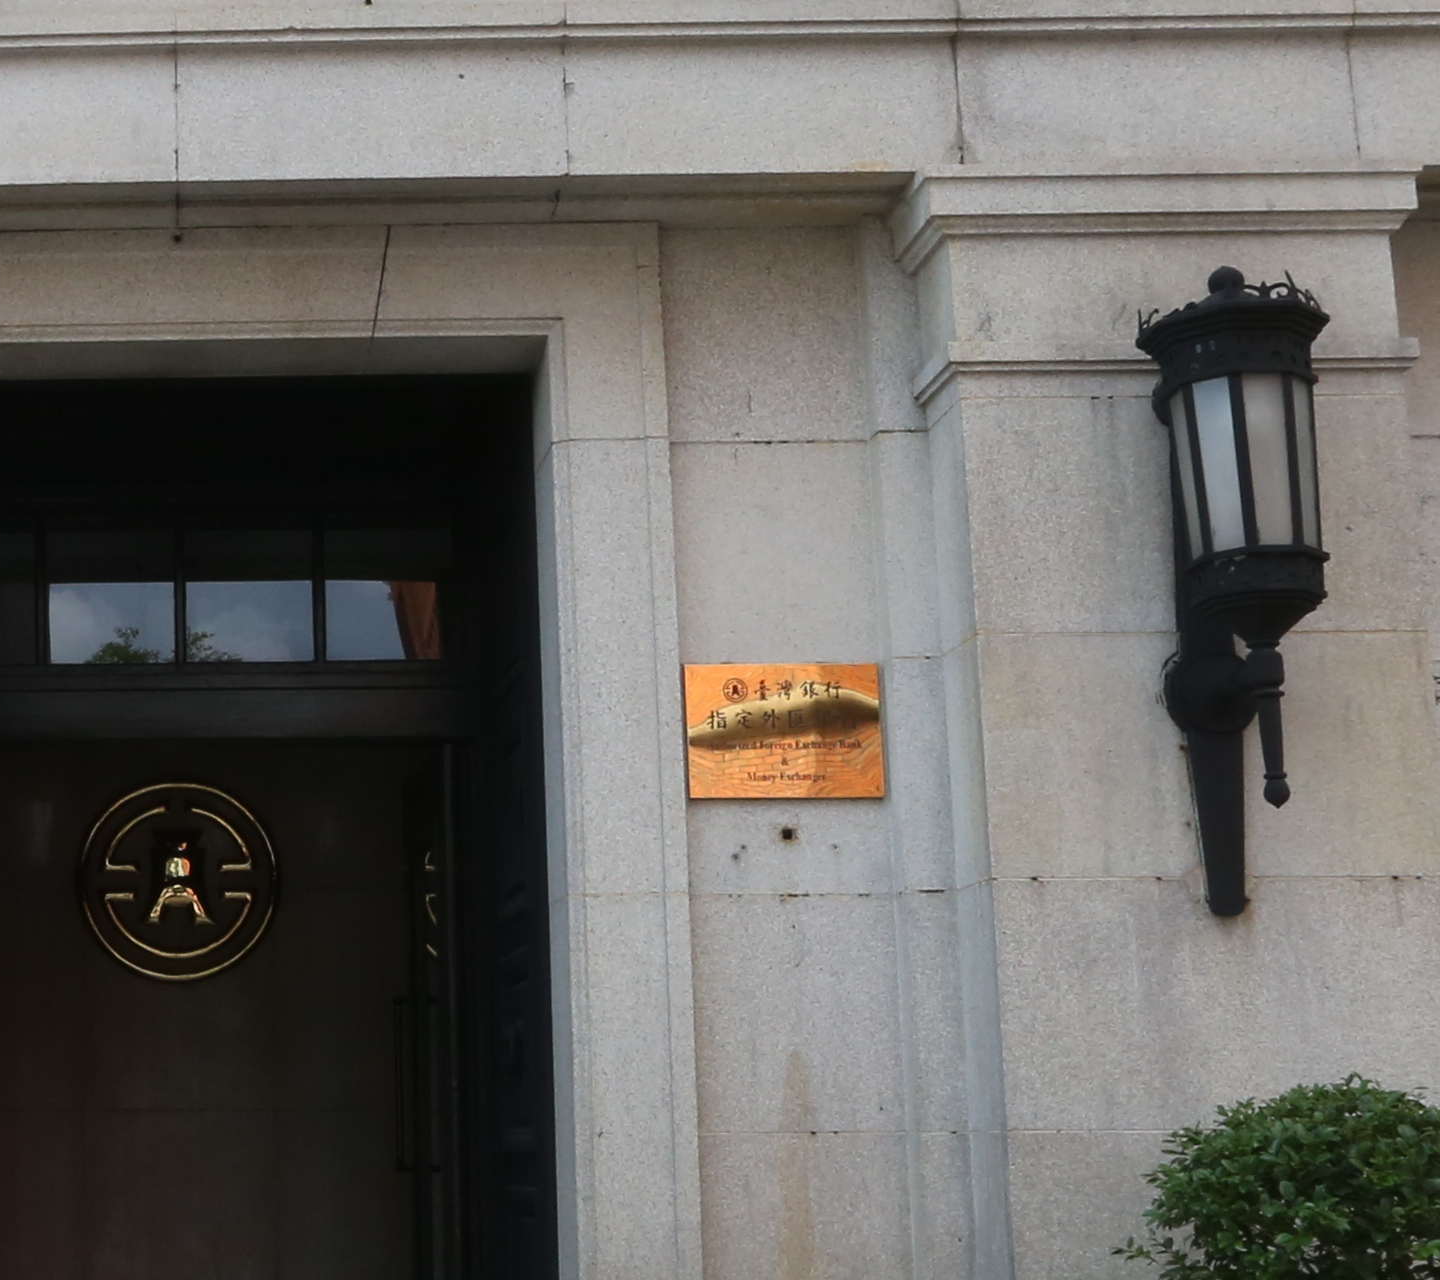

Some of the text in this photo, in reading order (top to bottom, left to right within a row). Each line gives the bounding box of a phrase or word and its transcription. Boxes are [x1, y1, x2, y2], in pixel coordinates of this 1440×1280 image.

[754, 679, 842, 701] 臺灣銀行
[760, 740, 793, 751] Foreign
[795, 740, 837, 751] Exchange
[839, 739, 862, 749] Bank
[780, 757, 789, 766] &
[747, 771, 776, 784] Money
